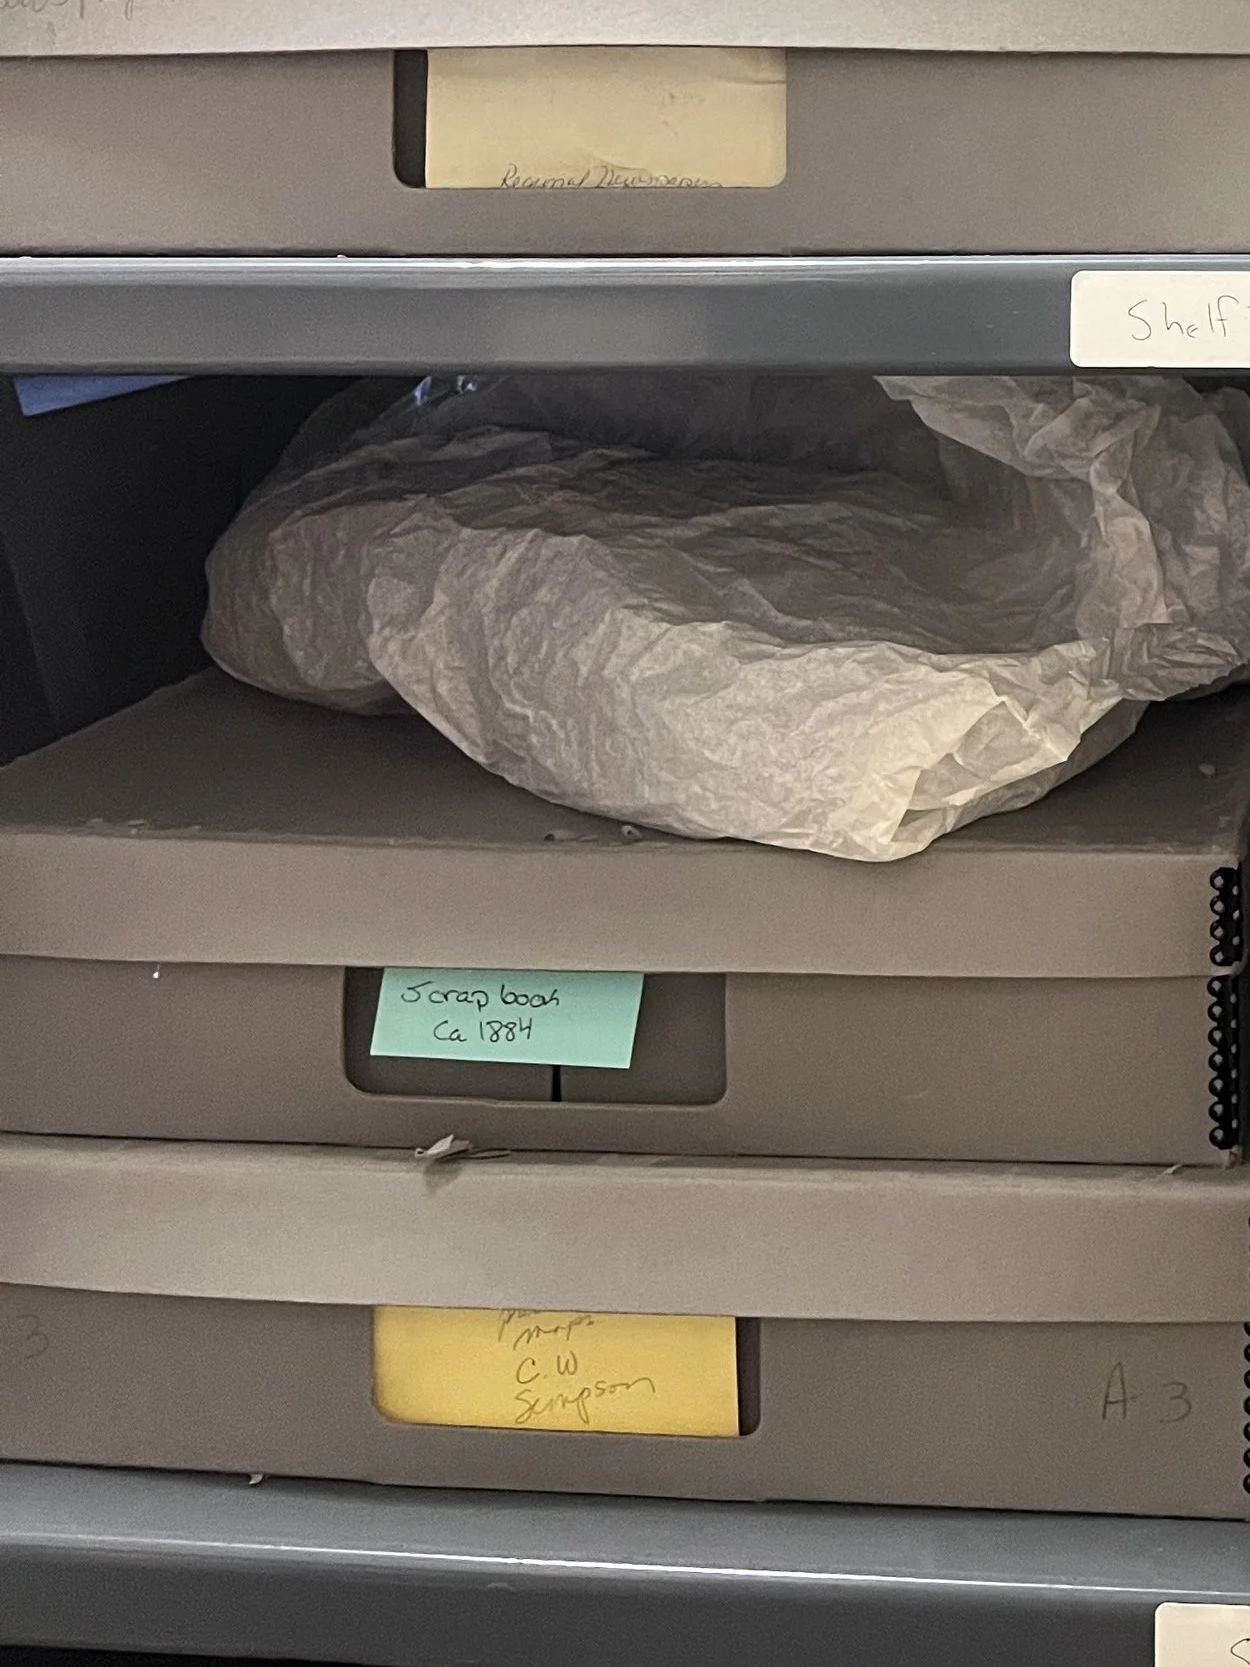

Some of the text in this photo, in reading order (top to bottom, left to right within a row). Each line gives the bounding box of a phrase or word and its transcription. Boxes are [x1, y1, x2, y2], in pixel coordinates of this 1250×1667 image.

[1127, 294, 1239, 341] Shelf
[432, 1017, 532, 1043] Ca 1884
